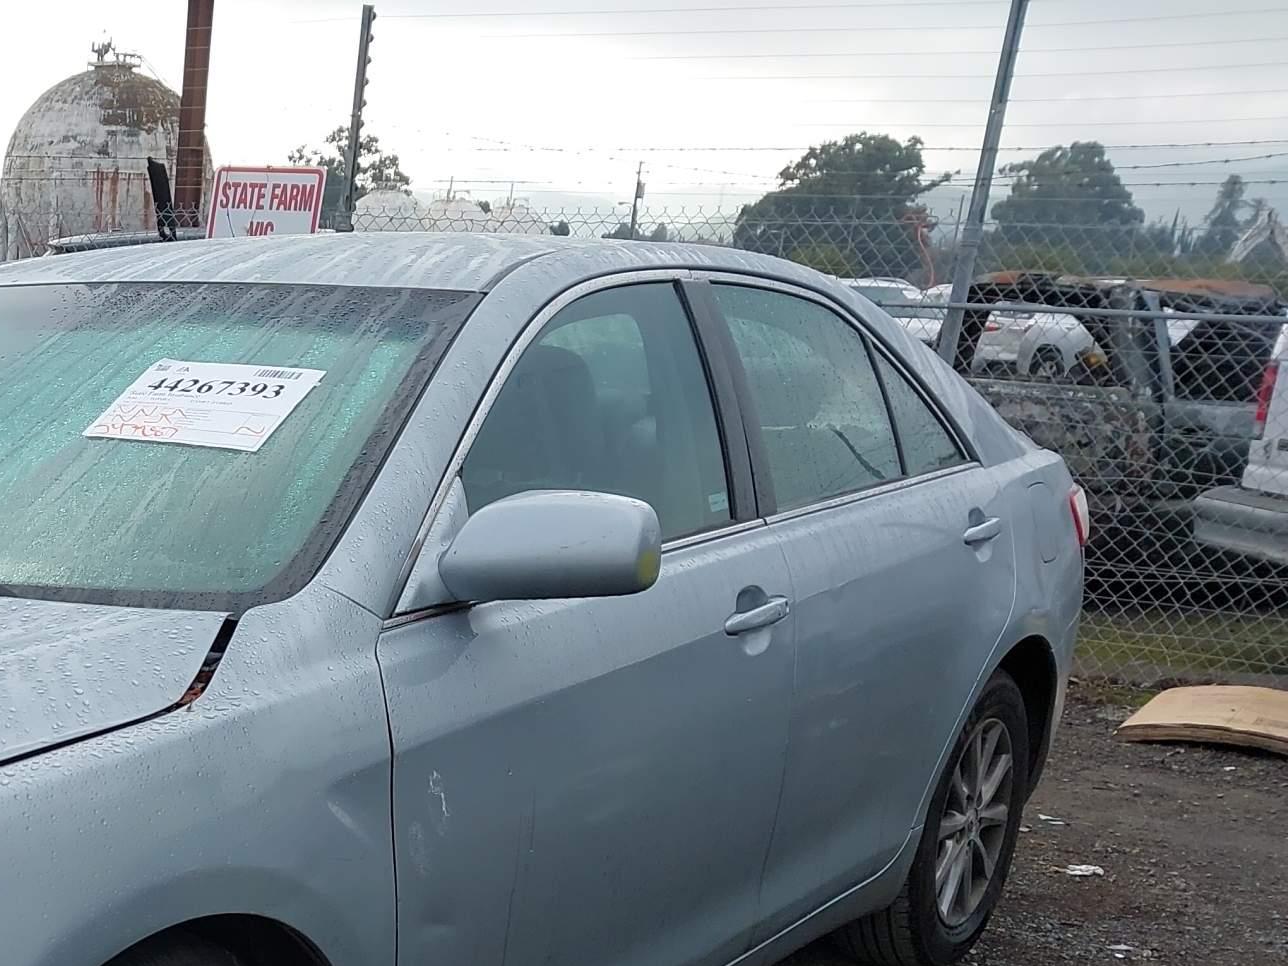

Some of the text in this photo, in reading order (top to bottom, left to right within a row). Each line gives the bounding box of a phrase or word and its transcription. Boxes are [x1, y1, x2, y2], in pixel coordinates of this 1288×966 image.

[220, 181, 315, 212] STATE FARM
[148, 377, 285, 399] 44267393
